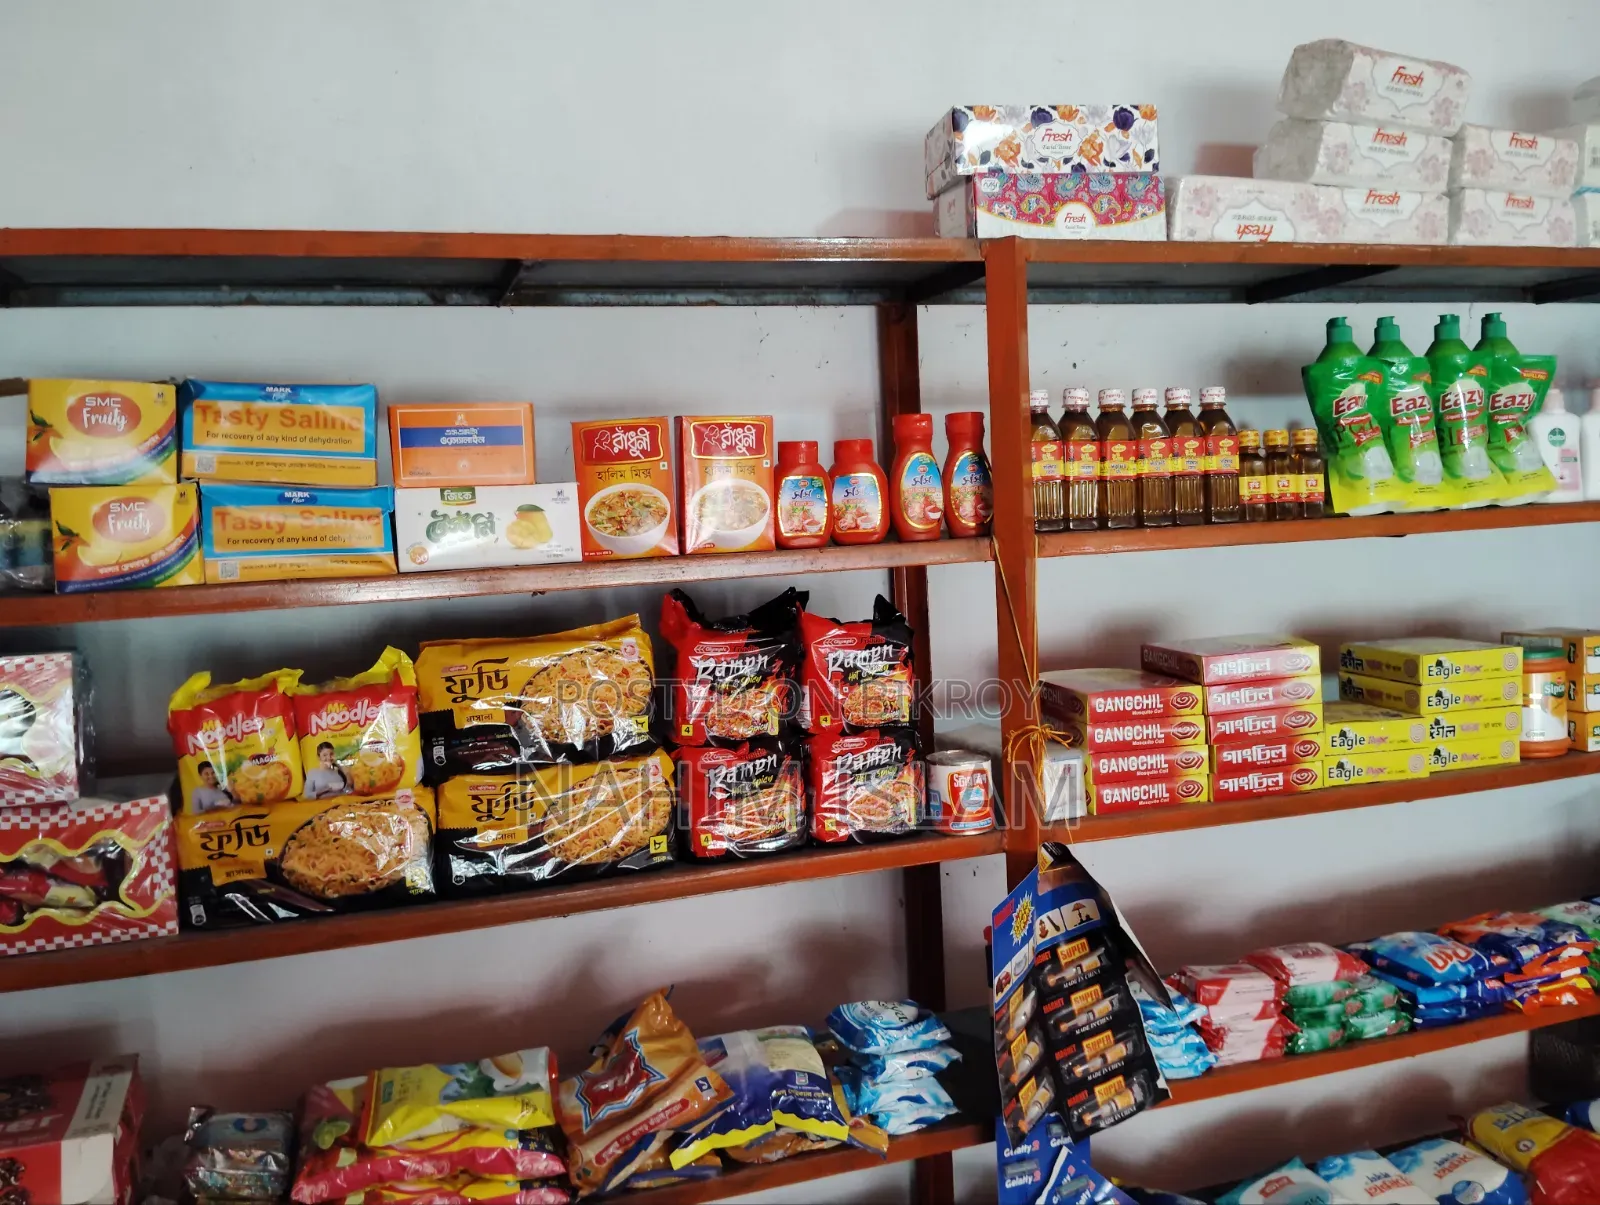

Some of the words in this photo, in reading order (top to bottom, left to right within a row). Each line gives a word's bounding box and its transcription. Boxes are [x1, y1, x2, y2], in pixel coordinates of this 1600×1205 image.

[1391, 65, 1424, 88] Fresh
[1041, 128, 1073, 143] Fresh
[1373, 127, 1408, 147] Fresh
[1509, 132, 1539, 151] Fresh
[1364, 187, 1401, 206] Fresh
[1505, 191, 1536, 210] Fresh
[1064, 212, 1086, 224] Fresh
[265, 386, 292, 394] MARK
[1441, 389, 1484, 411] Eazy
[85, 396, 122, 408] SMC
[1490, 392, 1535, 411] Eazy
[82, 407, 129, 432] Fruity
[196, 404, 269, 431] Tasty
[206, 430, 219, 438] For
[221, 431, 255, 441] recovery
[266, 434, 279, 443] any
[281, 434, 298, 443] kind
[299, 435, 307, 443] of
[309, 435, 352, 445] dehydration
[612, 426, 651, 459] রাঁধুনী
[720, 423, 757, 456] রাঁধুনী
[596, 467, 626, 481] হালিম
[110, 501, 146, 512] SMC
[107, 512, 154, 536] Fruity
[214, 510, 287, 535] Tasty
[227, 537, 240, 545] For
[242, 536, 275, 545] recovery
[277, 536, 284, 544] of
[286, 536, 300, 544] any
[301, 535, 318, 543] kind
[319, 534, 327, 542] of
[695, 653, 768, 685] Ramen
[826, 644, 893, 679] Ramen
[1428, 662, 1461, 679] Eagle
[1095, 693, 1164, 713] GANGCHIL
[1427, 692, 1461, 709] Eagle
[188, 712, 265, 757] Noodles
[684, 726, 691, 734] 4
[1094, 723, 1165, 744] GANGCHIL
[1331, 733, 1366, 751] Eagle
[833, 744, 902, 782] Ramen
[1099, 753, 1169, 774] GANGCHIL
[706, 753, 777, 794] Ramen
[1328, 766, 1364, 782] Eagle
[467, 779, 537, 823] ফুডি
[1102, 782, 1170, 804] GANGCHIL
[193, 814, 271, 860] ফুডি
[1060, 943, 1089, 961] SUPER
[1063, 978, 1078, 989] MADE
[1085, 970, 1101, 981] CHINA
[1072, 990, 1101, 1006] SUPER
[1075, 1024, 1091, 1035] MADE
[1096, 1015, 1113, 1027] CHINA
[1085, 1035, 1113, 1052] SUPER
[1087, 1070, 1102, 1081] MADE
[1102, 1068, 1108, 1076] IN
[1108, 1060, 1125, 1073] CHINA
[1097, 1081, 1125, 1098] SUPER
[1100, 1116, 1114, 1128] MADE
[1120, 1106, 1137, 1118] CHINA
